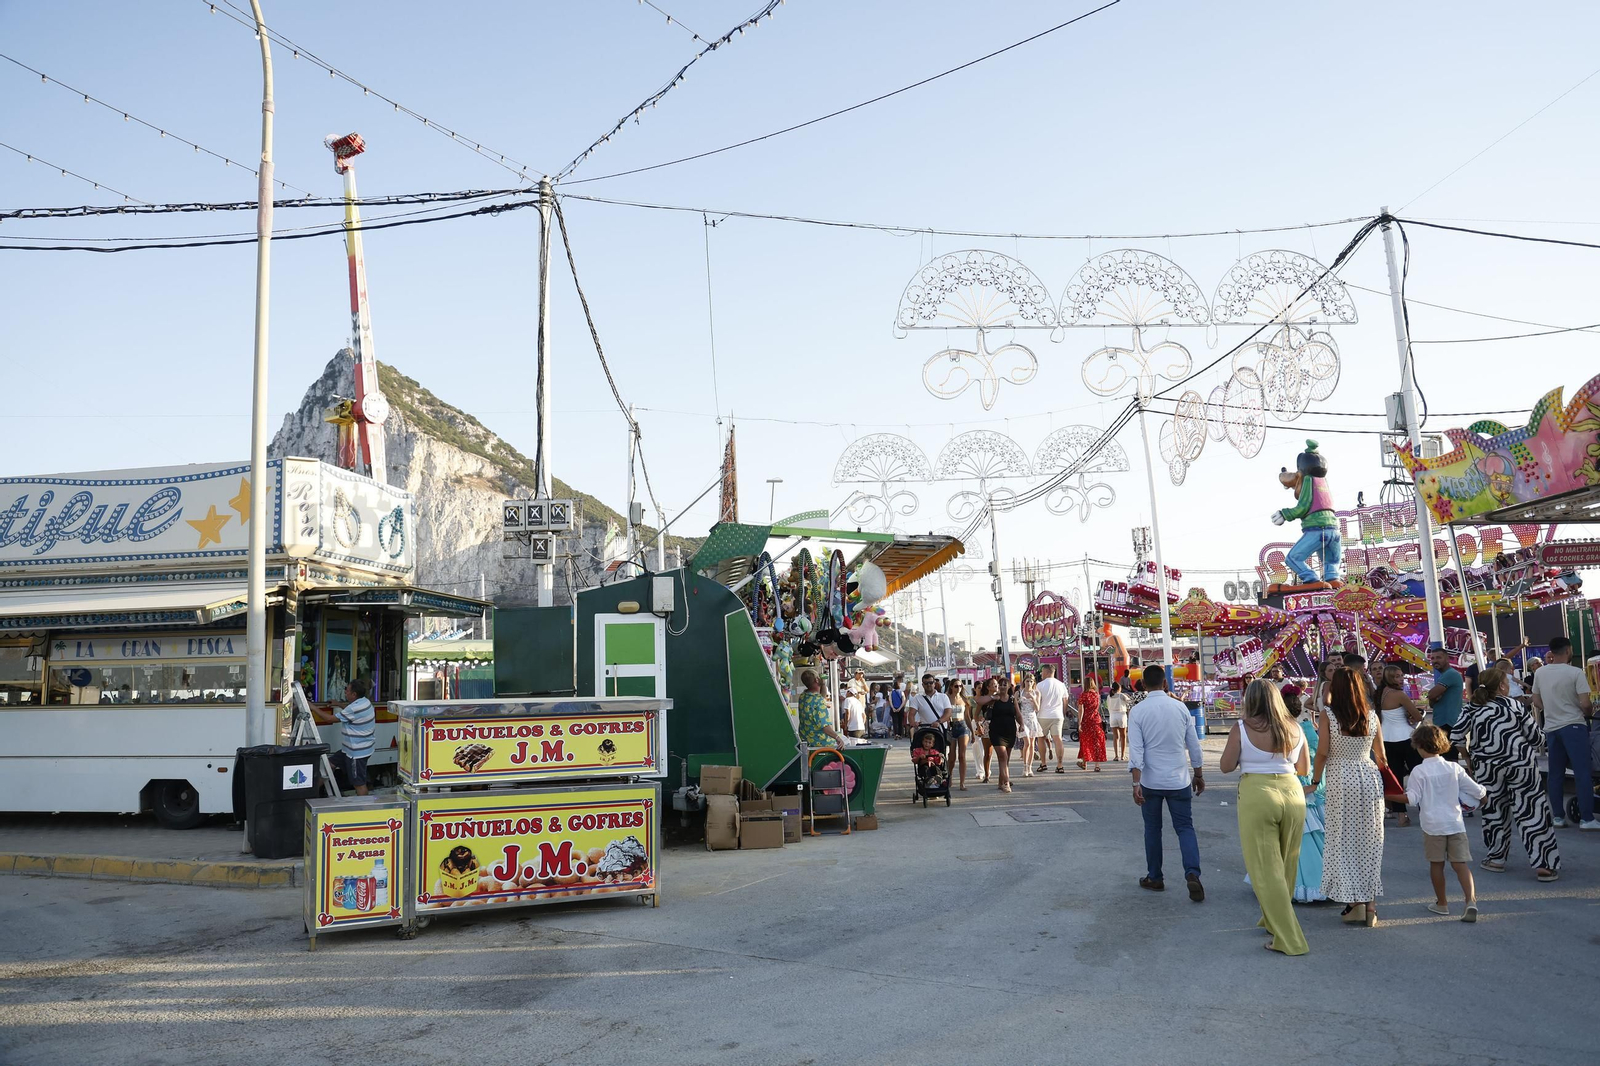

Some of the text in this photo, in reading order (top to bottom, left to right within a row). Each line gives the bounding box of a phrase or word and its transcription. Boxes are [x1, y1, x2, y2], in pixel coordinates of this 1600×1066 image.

[287, 481, 317, 538] Rosa
[1565, 545, 1600, 554] MALTRATA
[1031, 602, 1064, 621] SUPER
[1025, 614, 1075, 642] GOOFY
[75, 637, 234, 658] LA GRAN PESCA
[431, 721, 645, 742] BUÑUELOS & GOFRES
[510, 740, 575, 764] J.M.
[430, 811, 645, 840] BUÑUELOS & GOFRES
[332, 836, 390, 847] Refrescos
[336, 849, 386, 862] y Aguas
[493, 840, 588, 881] J.M.
[460, 877, 477, 890] J.M.
